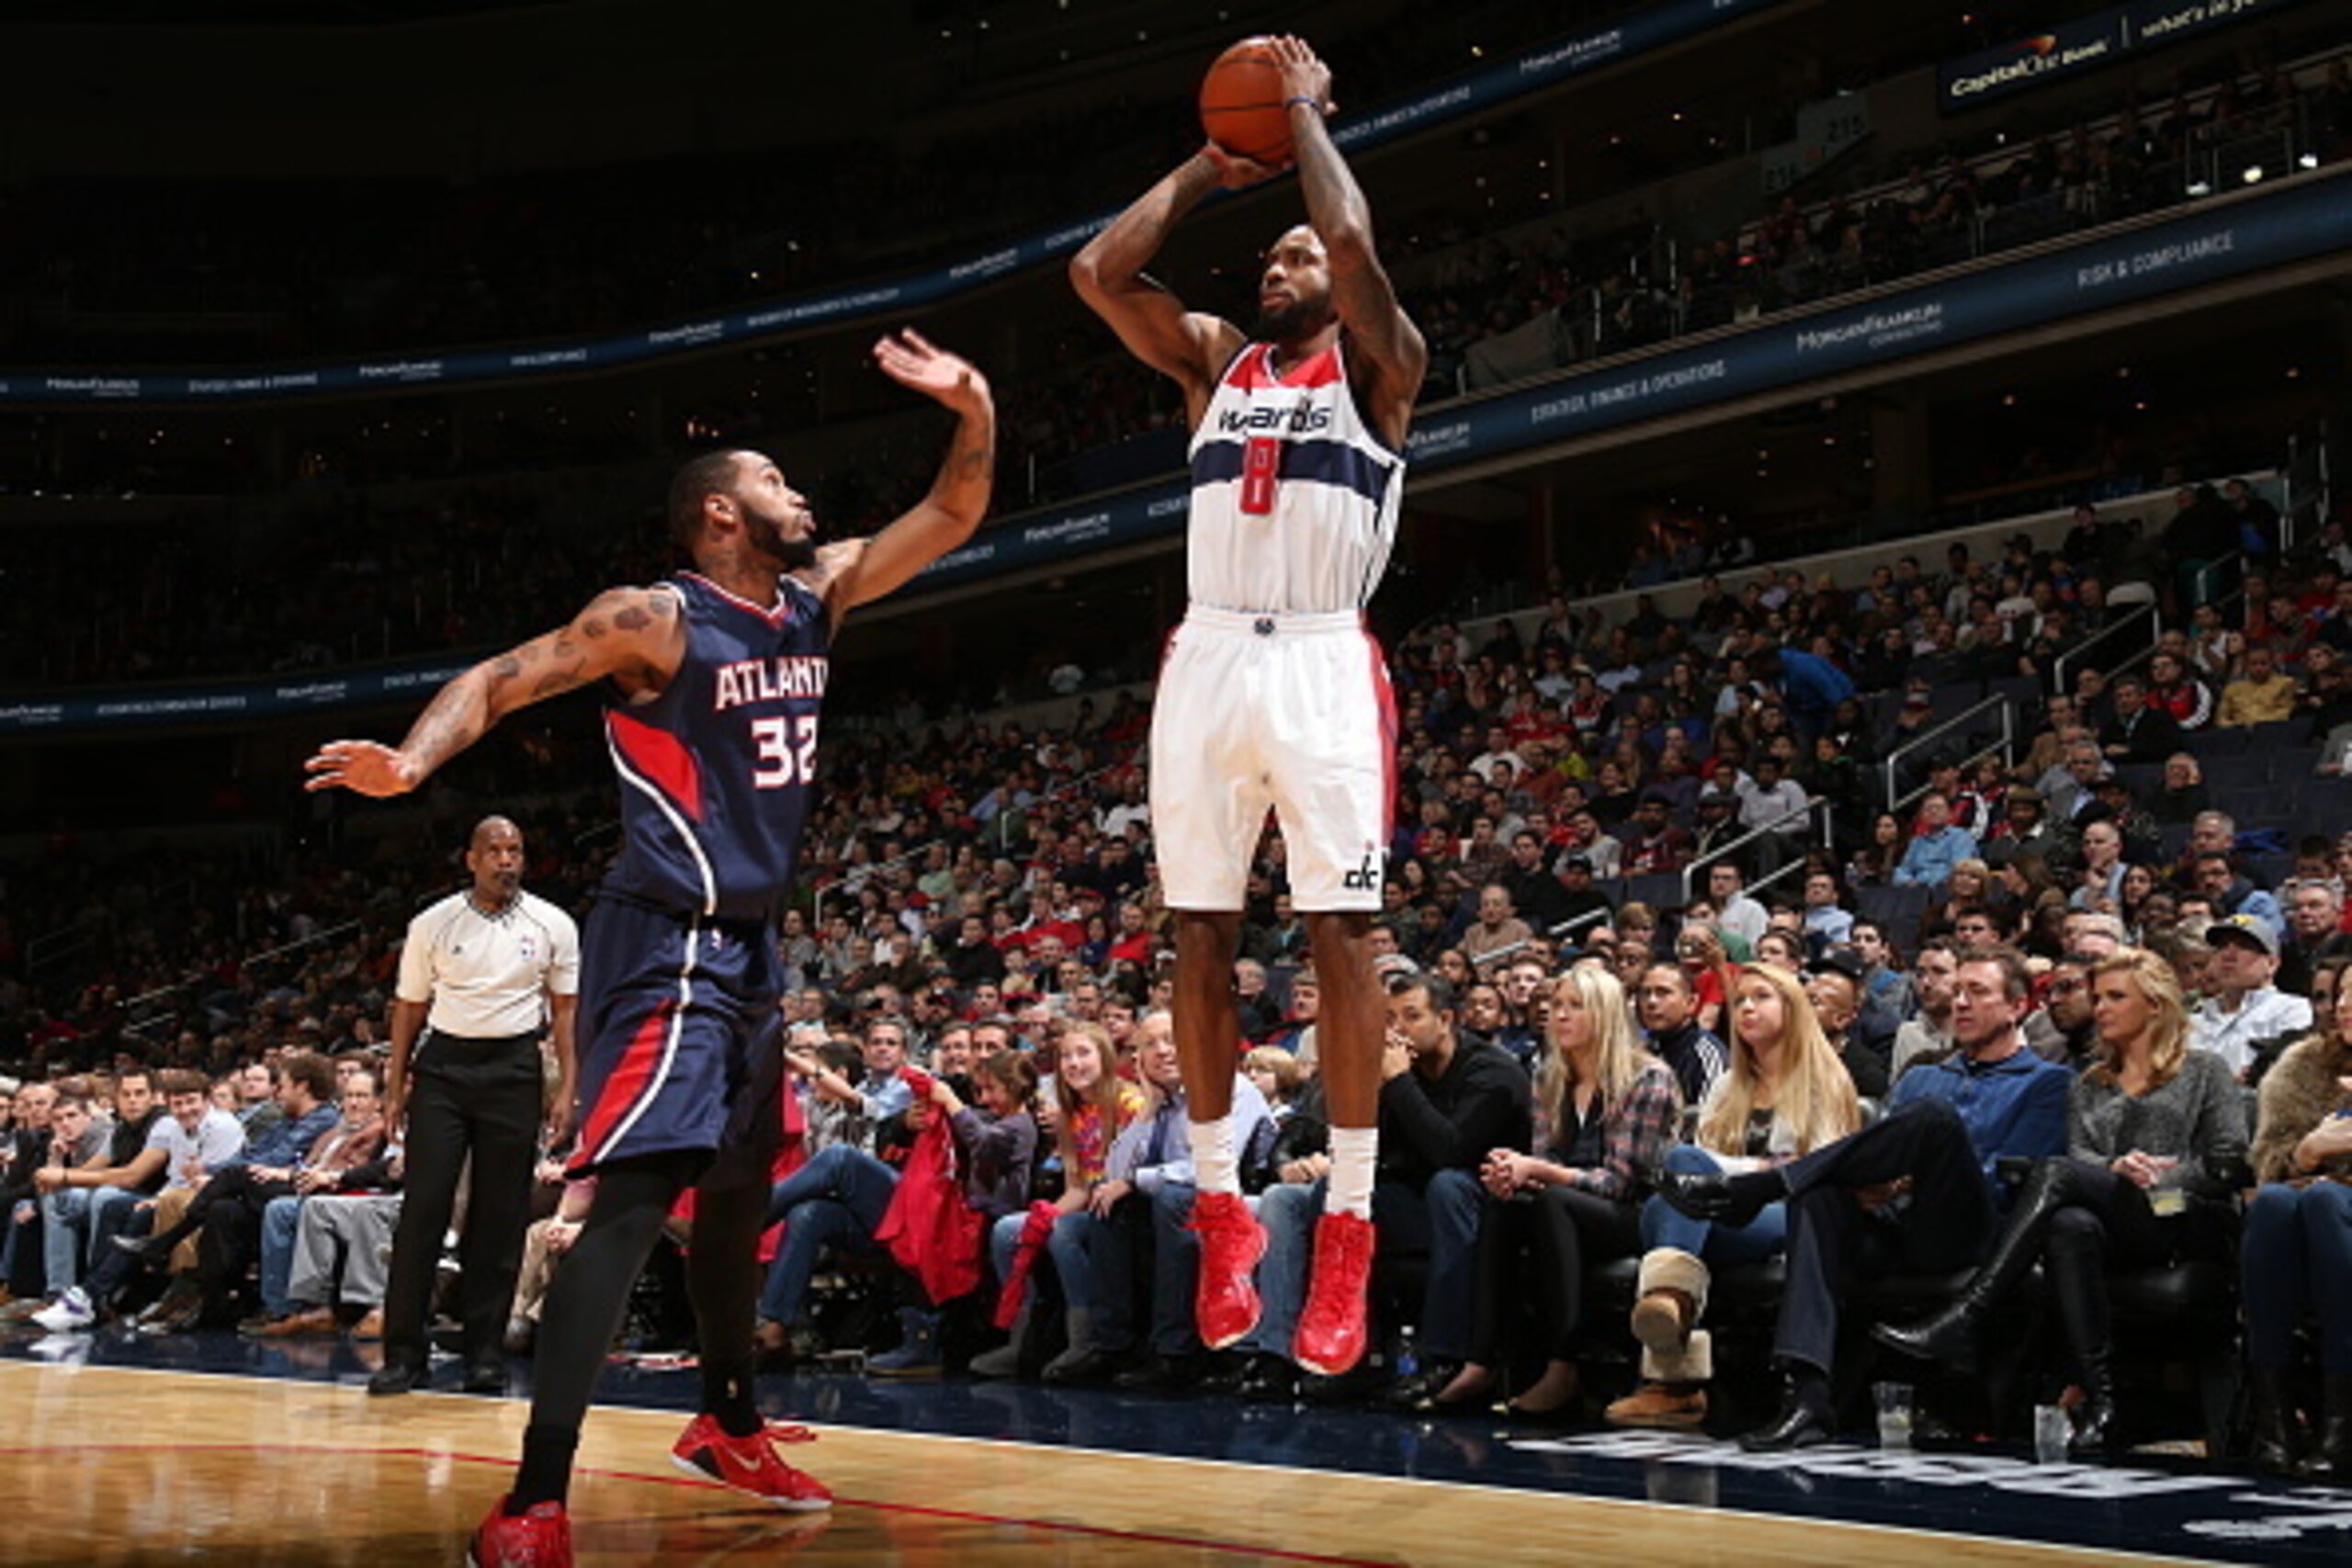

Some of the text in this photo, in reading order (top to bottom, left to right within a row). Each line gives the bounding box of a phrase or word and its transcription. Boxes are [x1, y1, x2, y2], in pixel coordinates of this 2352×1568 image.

[2131, 229, 2235, 276] COMPLIANCE
[1240, 435, 1281, 515] 8
[715, 655, 830, 712] ATLANT
[752, 716, 818, 788] 32
